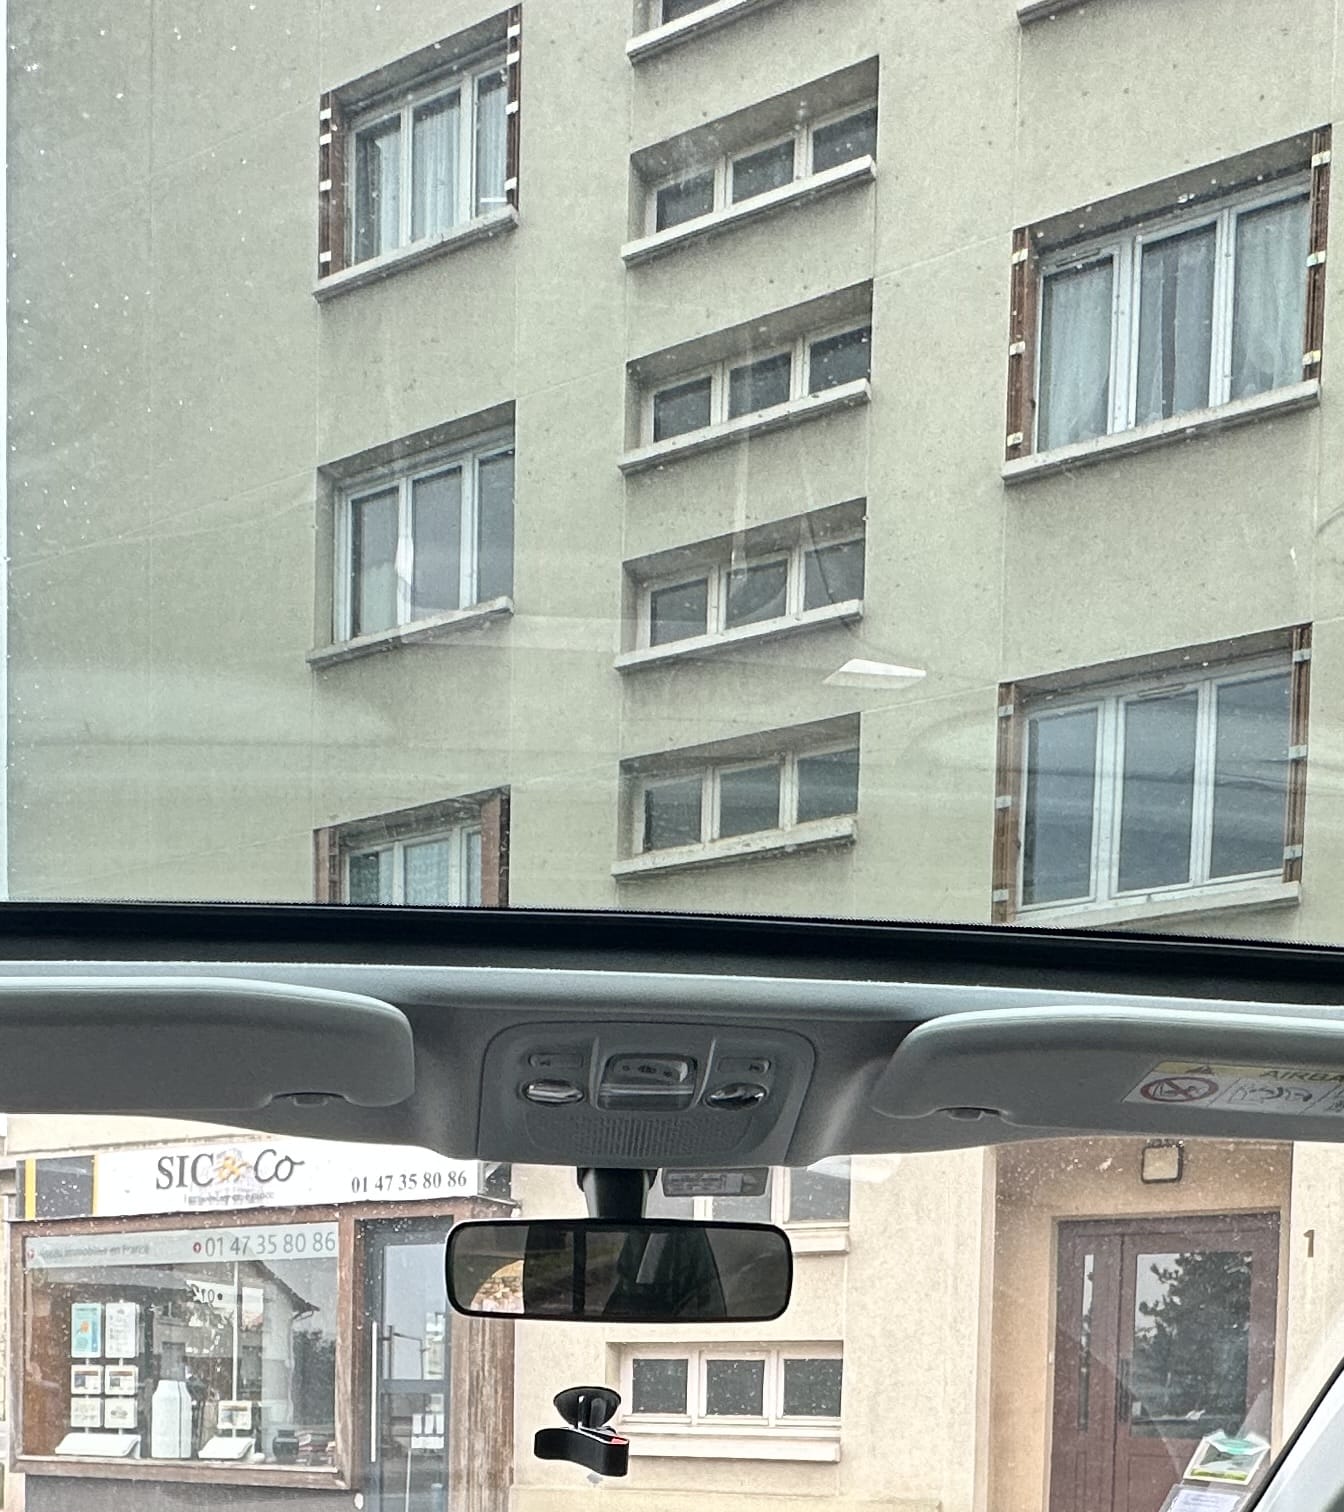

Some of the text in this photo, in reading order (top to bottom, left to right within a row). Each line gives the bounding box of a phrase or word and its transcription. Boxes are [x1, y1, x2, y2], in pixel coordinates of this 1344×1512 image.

[156, 1153, 214, 1189] SIC
[253, 1149, 305, 1183] Co
[351, 1170, 467, 1194] 01 47 35 80 86
[205, 1236, 224, 1257] 01
[230, 1235, 251, 1256] 47
[256, 1234, 277, 1254] 35
[283, 1233, 306, 1253] 80
[312, 1231, 336, 1252] 86
[1303, 1229, 1315, 1258] 1
